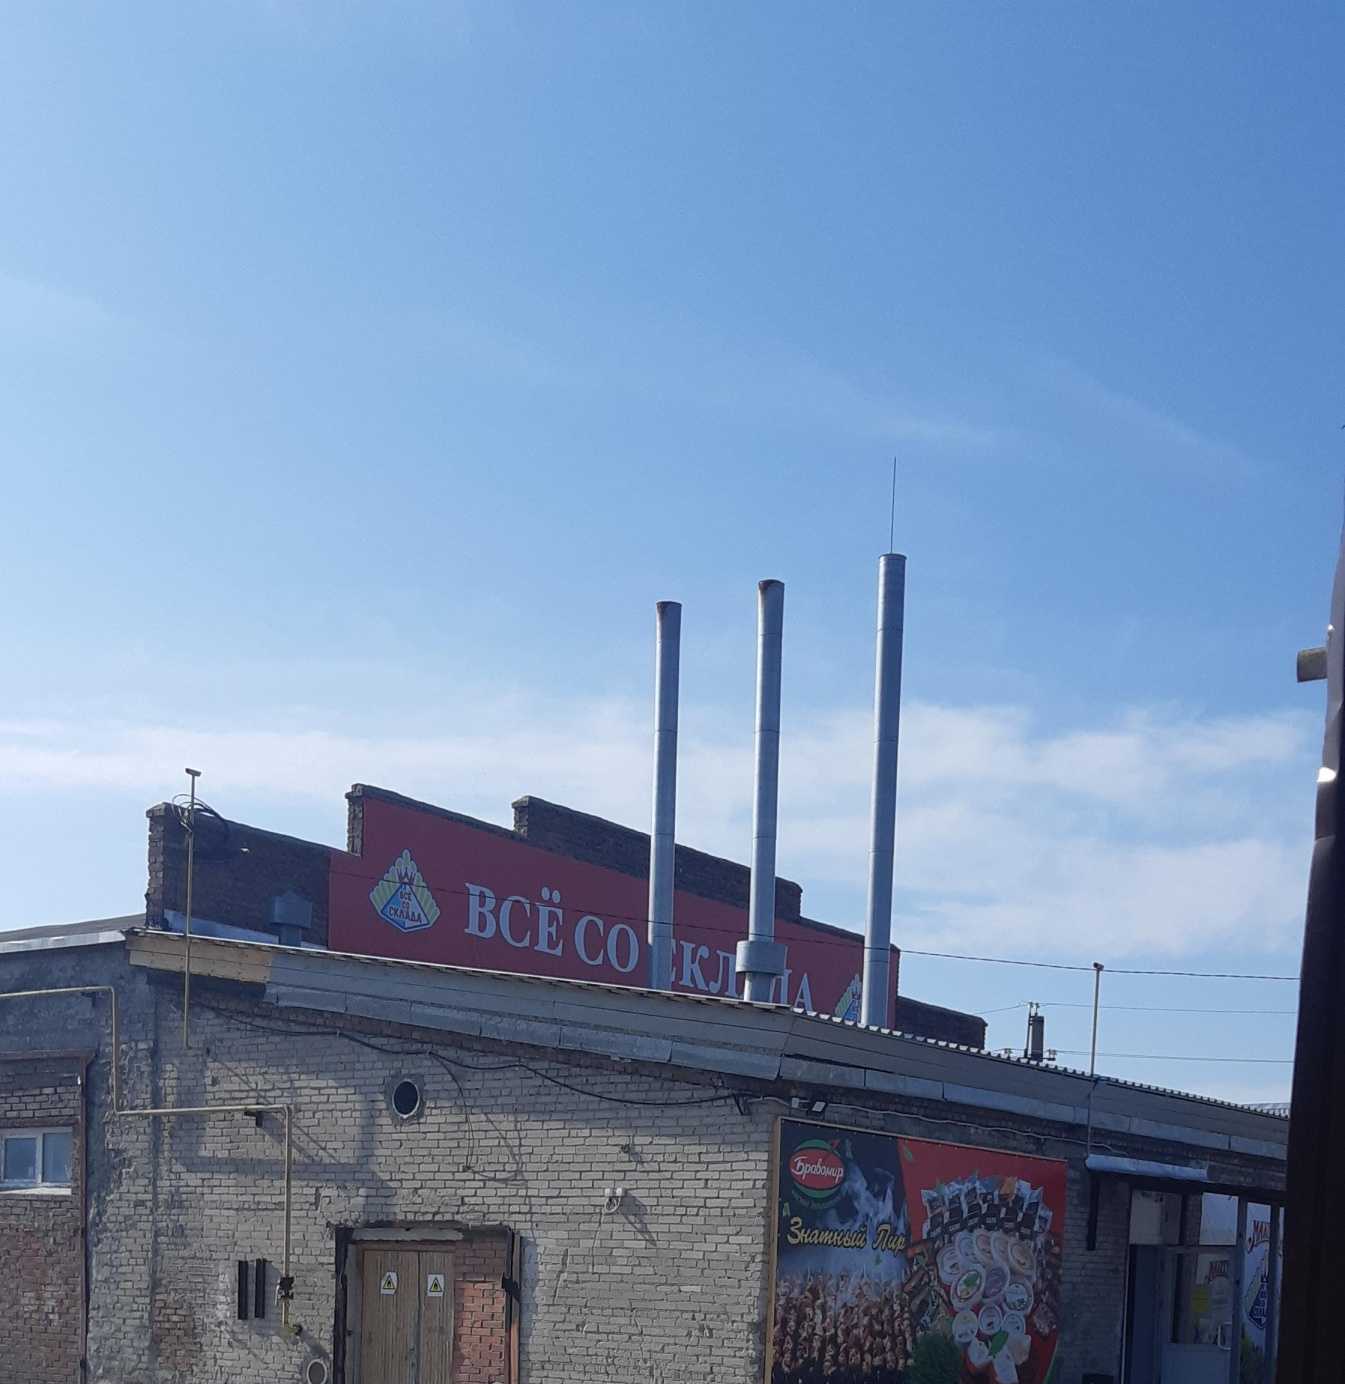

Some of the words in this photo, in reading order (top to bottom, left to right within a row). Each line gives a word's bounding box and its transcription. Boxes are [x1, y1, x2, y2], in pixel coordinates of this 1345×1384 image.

[388, 906, 423, 923] СКЛАДА
[464, 882, 566, 957] ВСЁ
[574, 914, 640, 974] СО
[790, 1155, 844, 1184] Бравомир
[787, 1216, 866, 1247] Знатный
[873, 1223, 907, 1255] Пир
